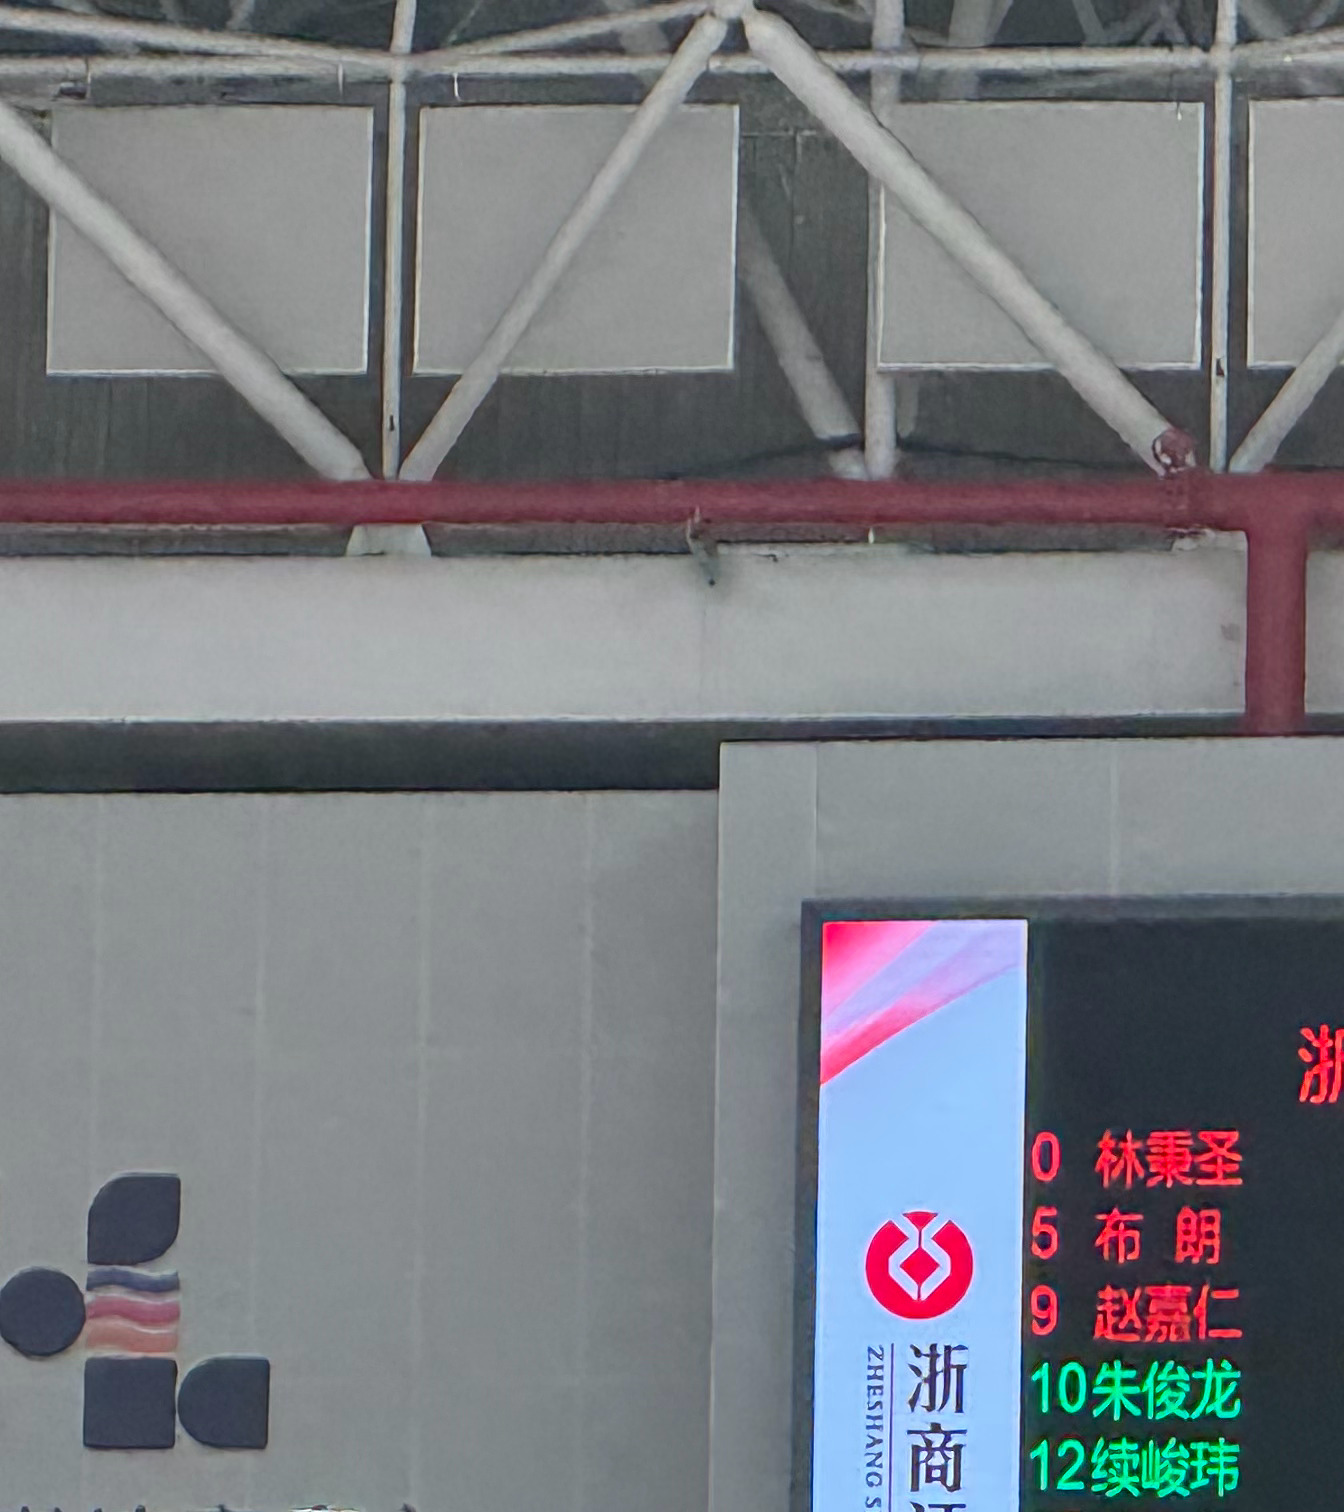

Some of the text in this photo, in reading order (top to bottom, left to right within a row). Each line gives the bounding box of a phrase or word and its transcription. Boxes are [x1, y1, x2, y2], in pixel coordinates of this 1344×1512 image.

[1032, 1130, 1060, 1180] 0
[1095, 1130, 1242, 1188] 林秉圣
[1031, 1206, 1058, 1256] 5
[1030, 1284, 1058, 1335] 9
[1094, 1284, 1243, 1343] 赵嘉仁
[863, 1345, 885, 1487] ZHESHANG
